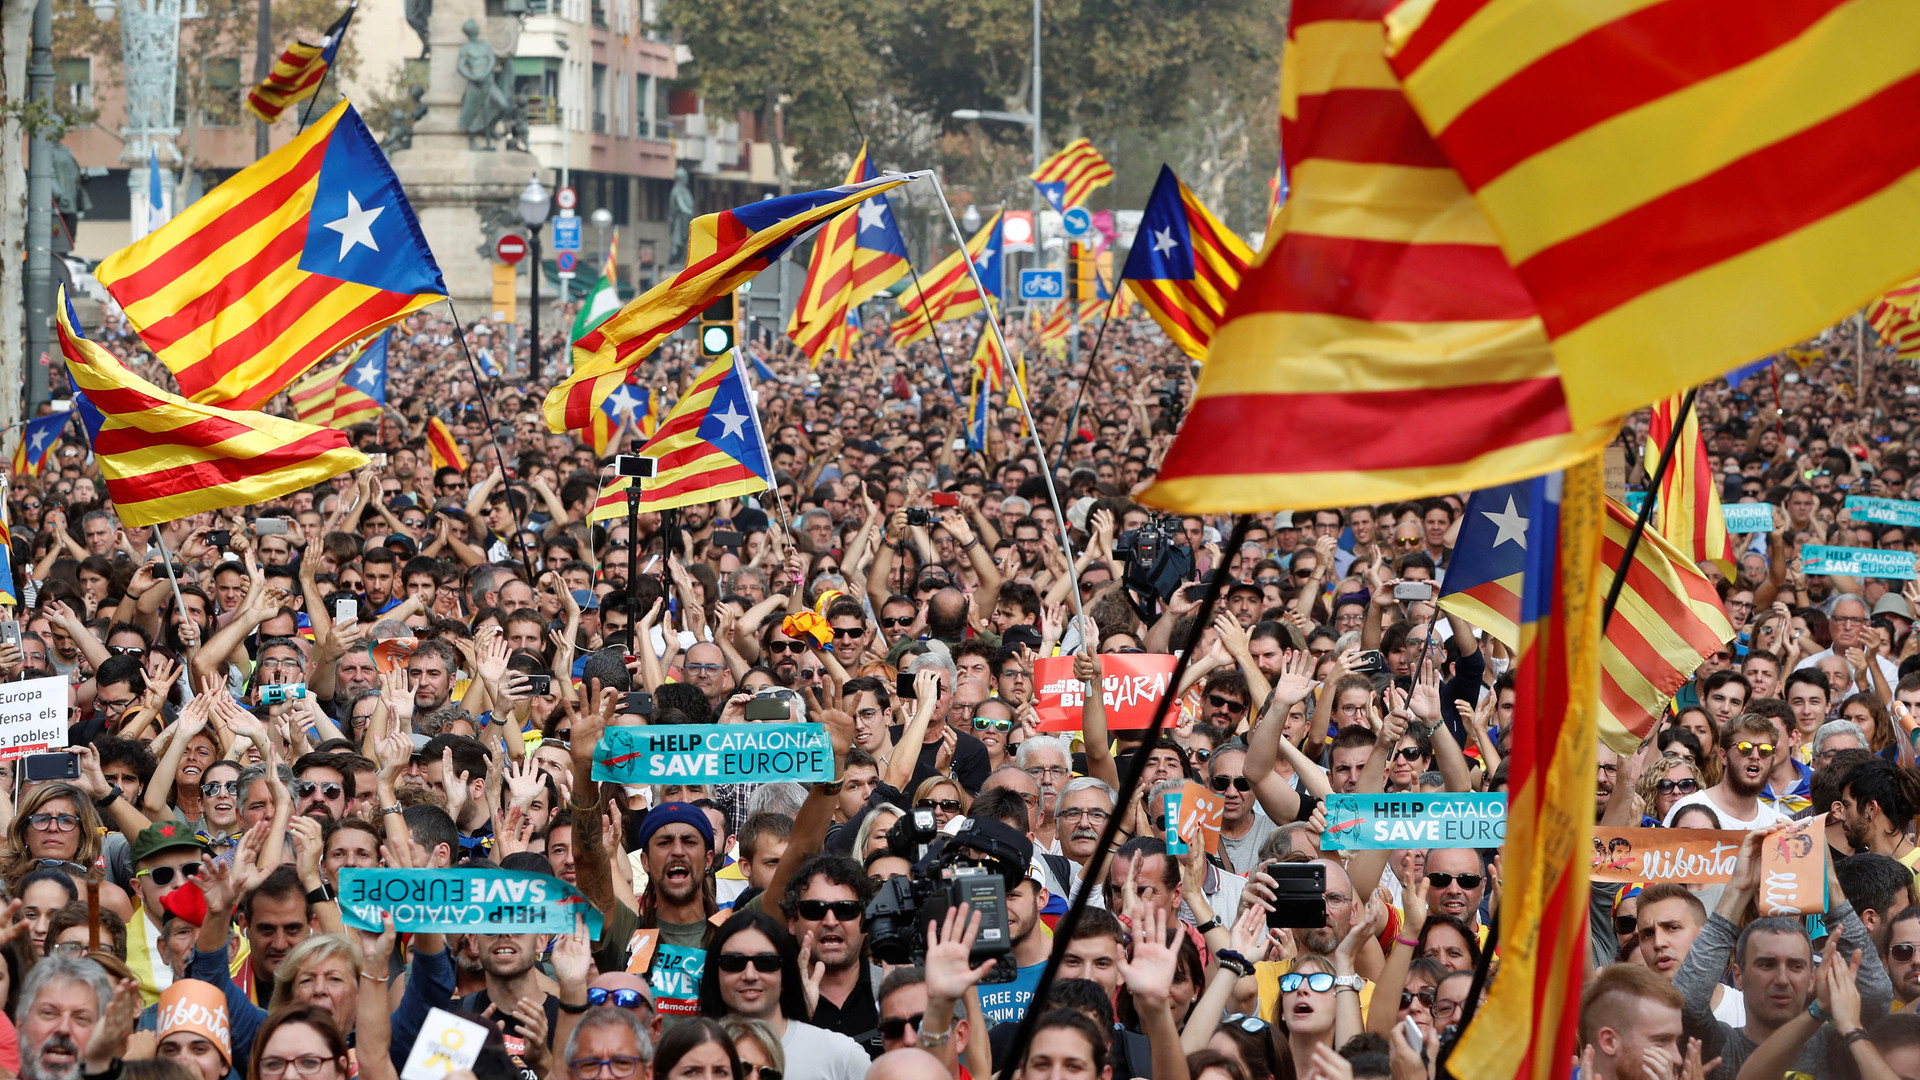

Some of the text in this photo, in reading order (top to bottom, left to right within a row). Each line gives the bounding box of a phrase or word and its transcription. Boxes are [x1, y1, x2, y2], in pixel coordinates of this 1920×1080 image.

[1867, 507, 1897, 521] SAVE
[1824, 559, 1911, 575] SAVE EUROPE
[1826, 550, 1912, 566] HELP CATALONIA
[39, 707, 57, 720] els
[13, 727, 60, 747] pobles!
[649, 731, 823, 753] HELP CATALONIA
[649, 750, 824, 777] SAVE EUROPE
[1374, 801, 1508, 819] HELP CATALO
[1373, 820, 1440, 842] SAVE
[352, 877, 547, 904] SAVE EUROPE
[352, 903, 546, 925] HELP CATALONIA
[982, 990, 1012, 1008] FREE
